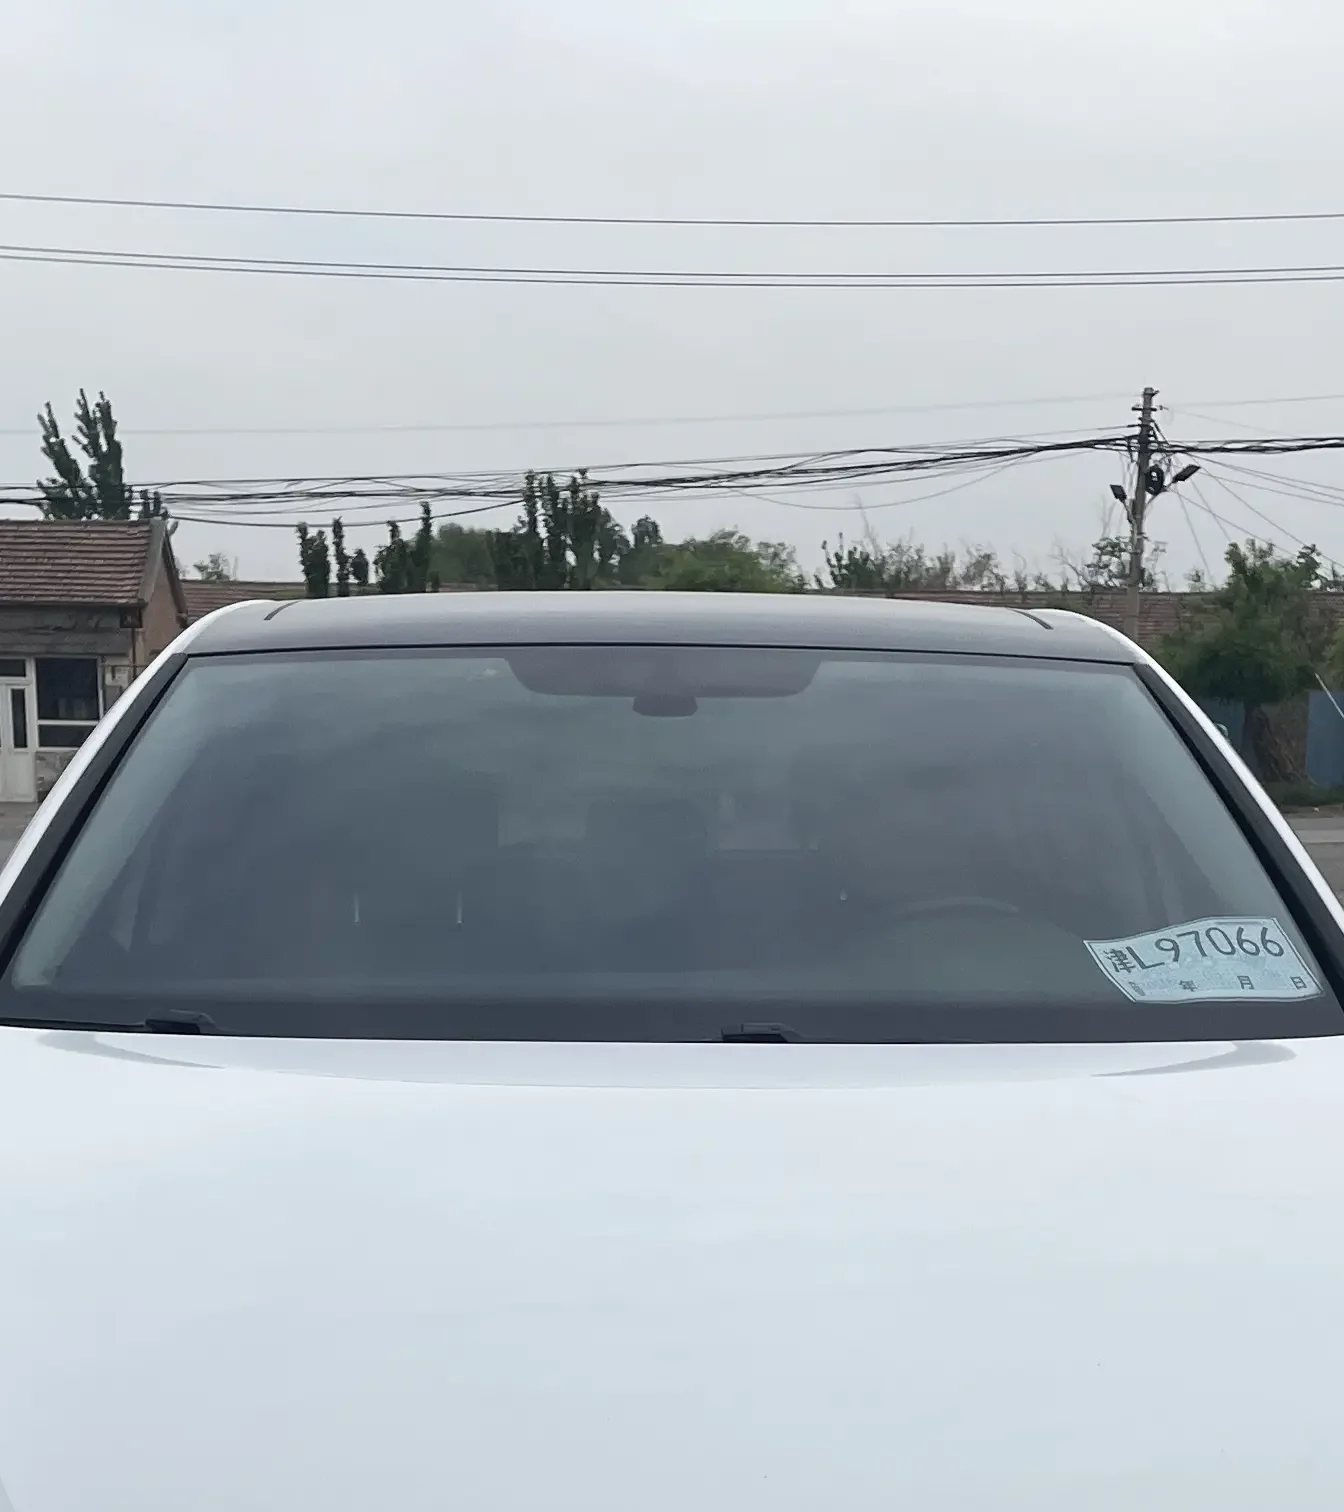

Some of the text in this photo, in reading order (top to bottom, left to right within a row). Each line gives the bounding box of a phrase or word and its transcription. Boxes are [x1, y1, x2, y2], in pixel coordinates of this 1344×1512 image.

[1103, 926, 1285, 974] 津L97066
[1237, 975, 1255, 990] 月
[1291, 976, 1308, 989] 日
